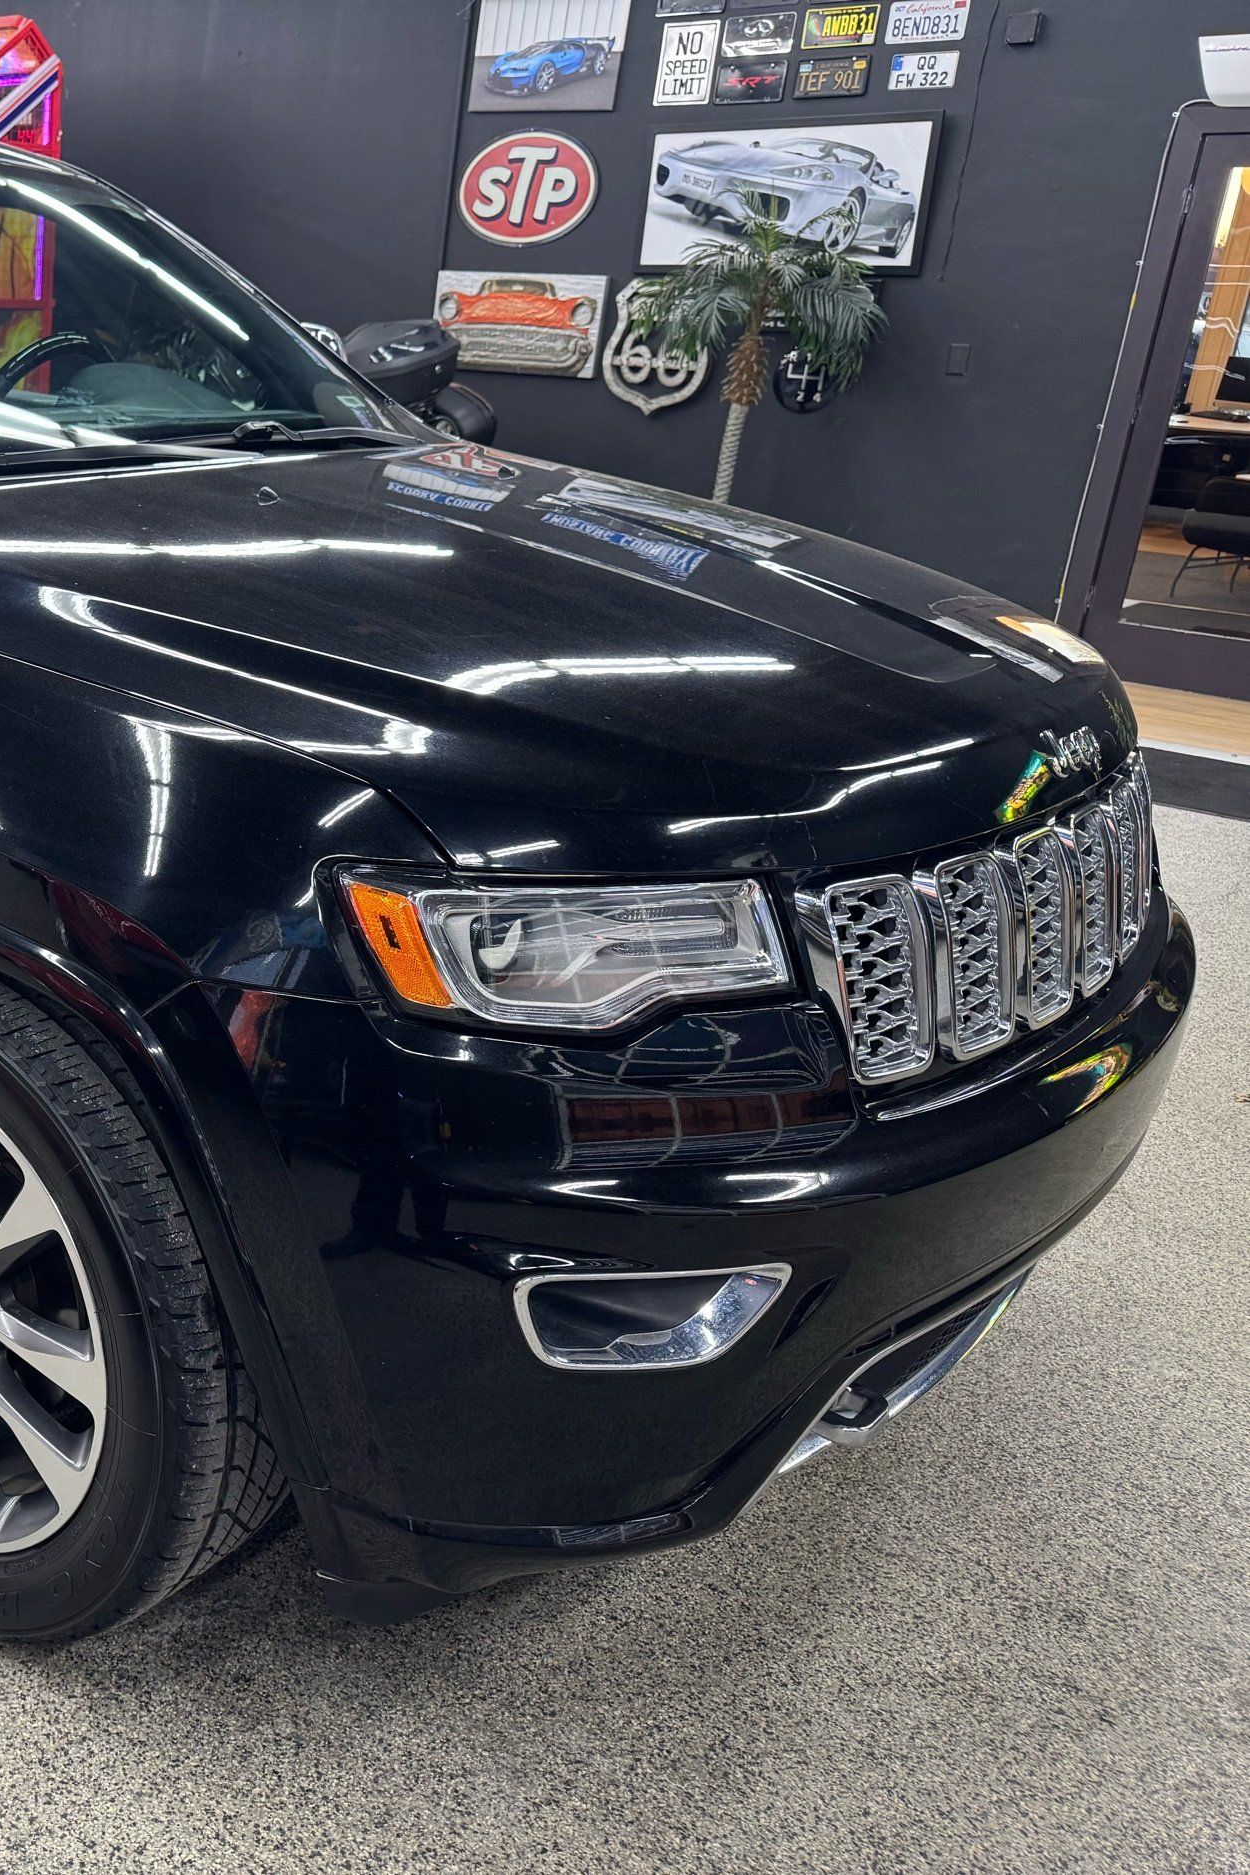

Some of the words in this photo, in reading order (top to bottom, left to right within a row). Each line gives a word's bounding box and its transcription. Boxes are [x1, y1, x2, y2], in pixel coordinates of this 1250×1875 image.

[906, 3, 954, 16] California
[892, 13, 960, 38] 8END831
[675, 31, 704, 56] NO
[664, 58, 708, 76] SPEED
[917, 55, 937, 70] QQ
[662, 77, 706, 96] LIMIT
[723, 75, 781, 88] SRT
[799, 71, 830, 92] TEF
[833, 69, 861, 90] 901
[895, 73, 916, 88] FW
[919, 71, 949, 87] 322
[471, 145, 578, 227] STP
